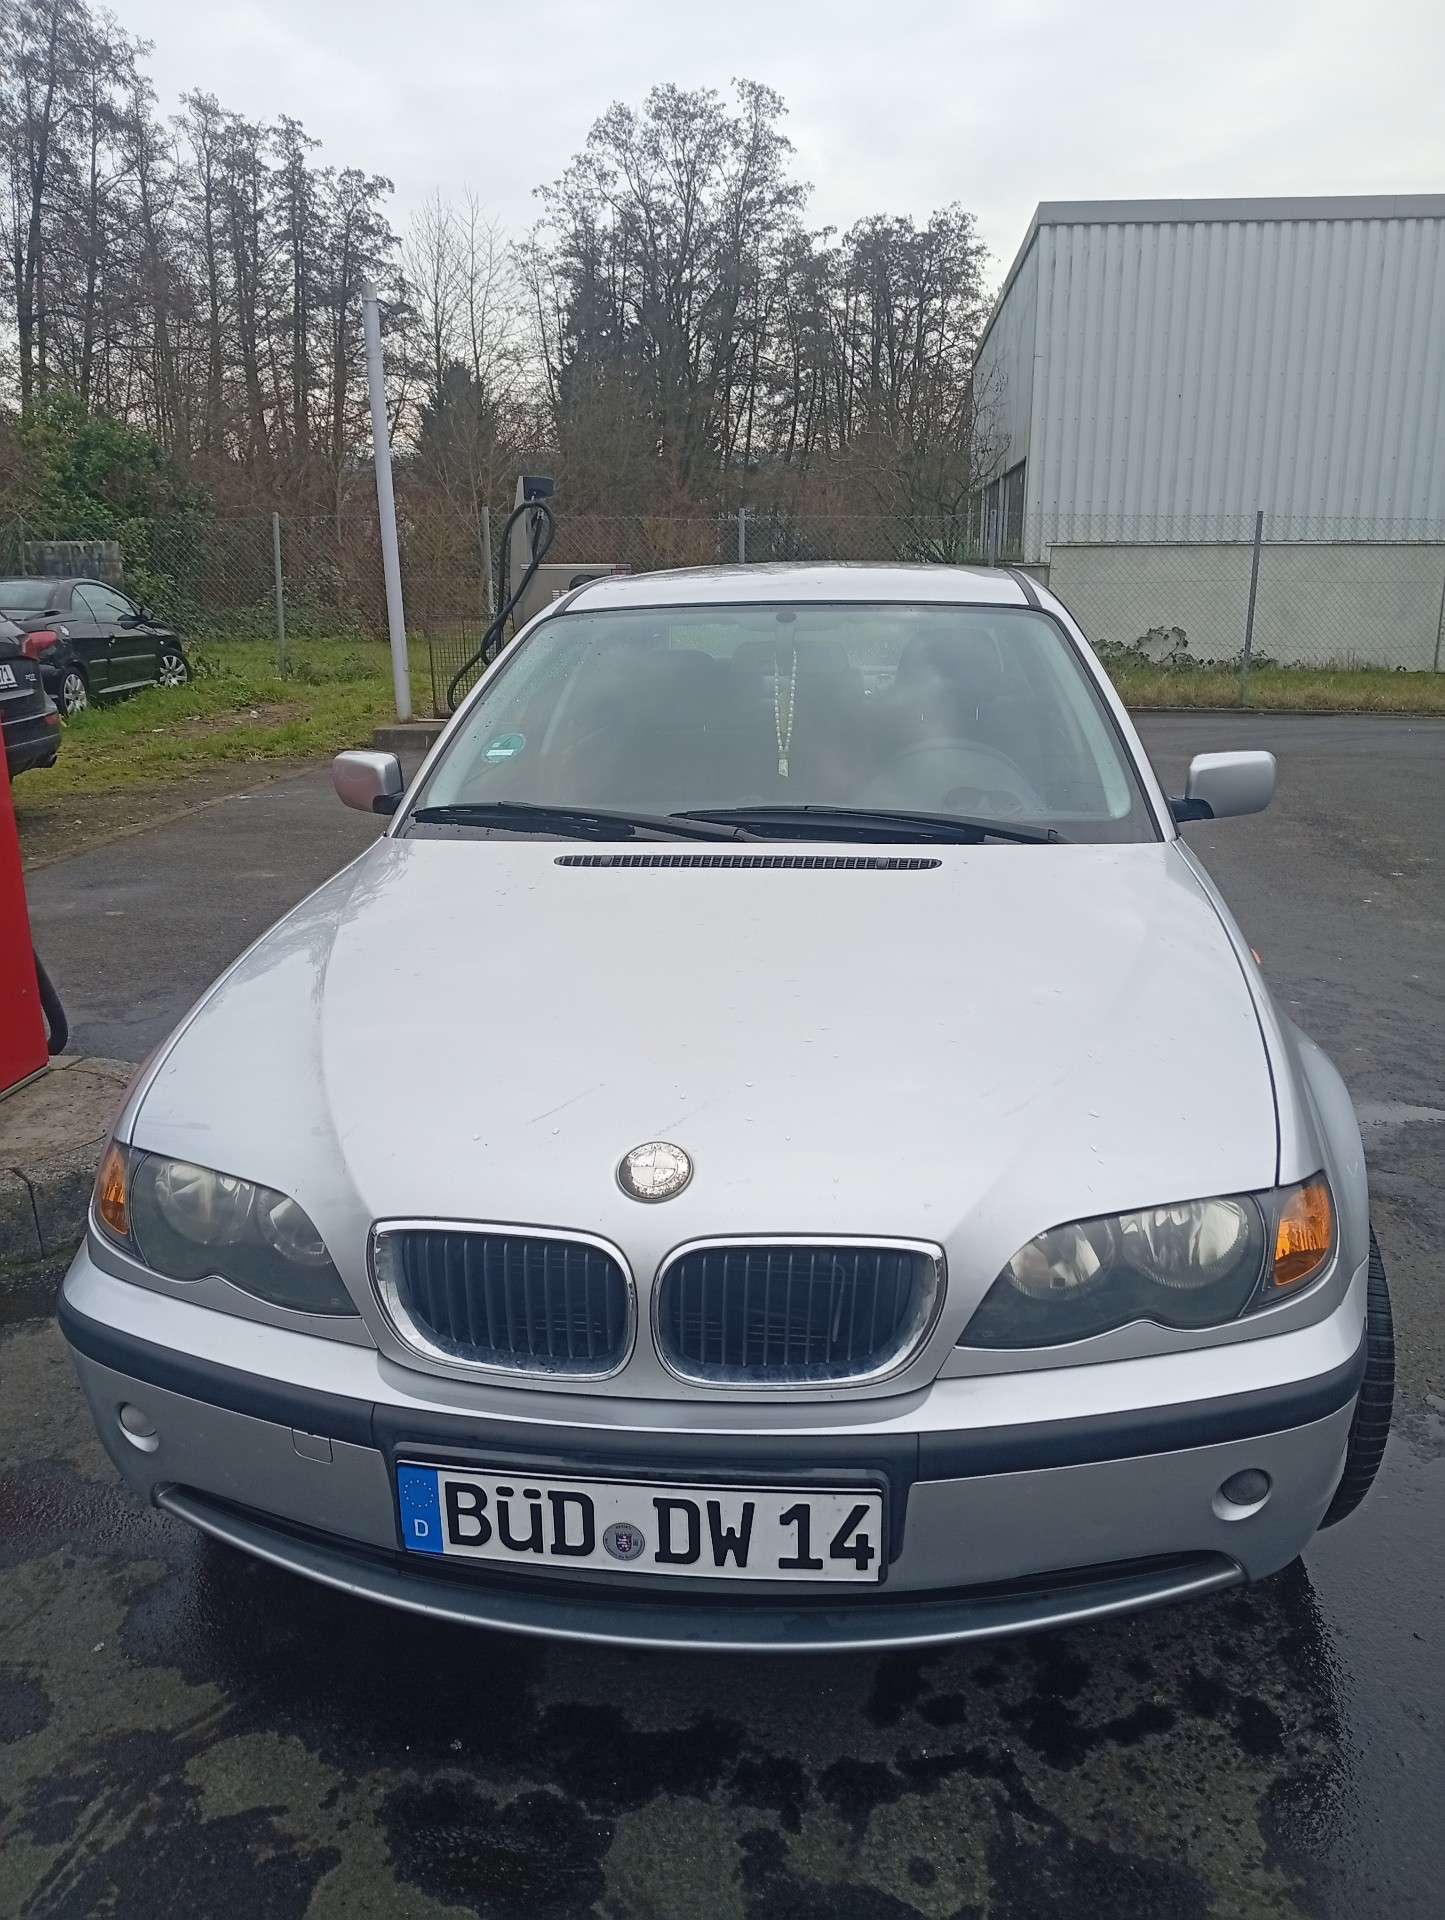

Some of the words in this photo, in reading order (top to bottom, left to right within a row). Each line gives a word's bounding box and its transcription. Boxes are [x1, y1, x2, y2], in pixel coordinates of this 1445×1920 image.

[414, 1519, 429, 1537] D
[653, 1497, 755, 1568] DW
[779, 1503, 875, 1570] 14
